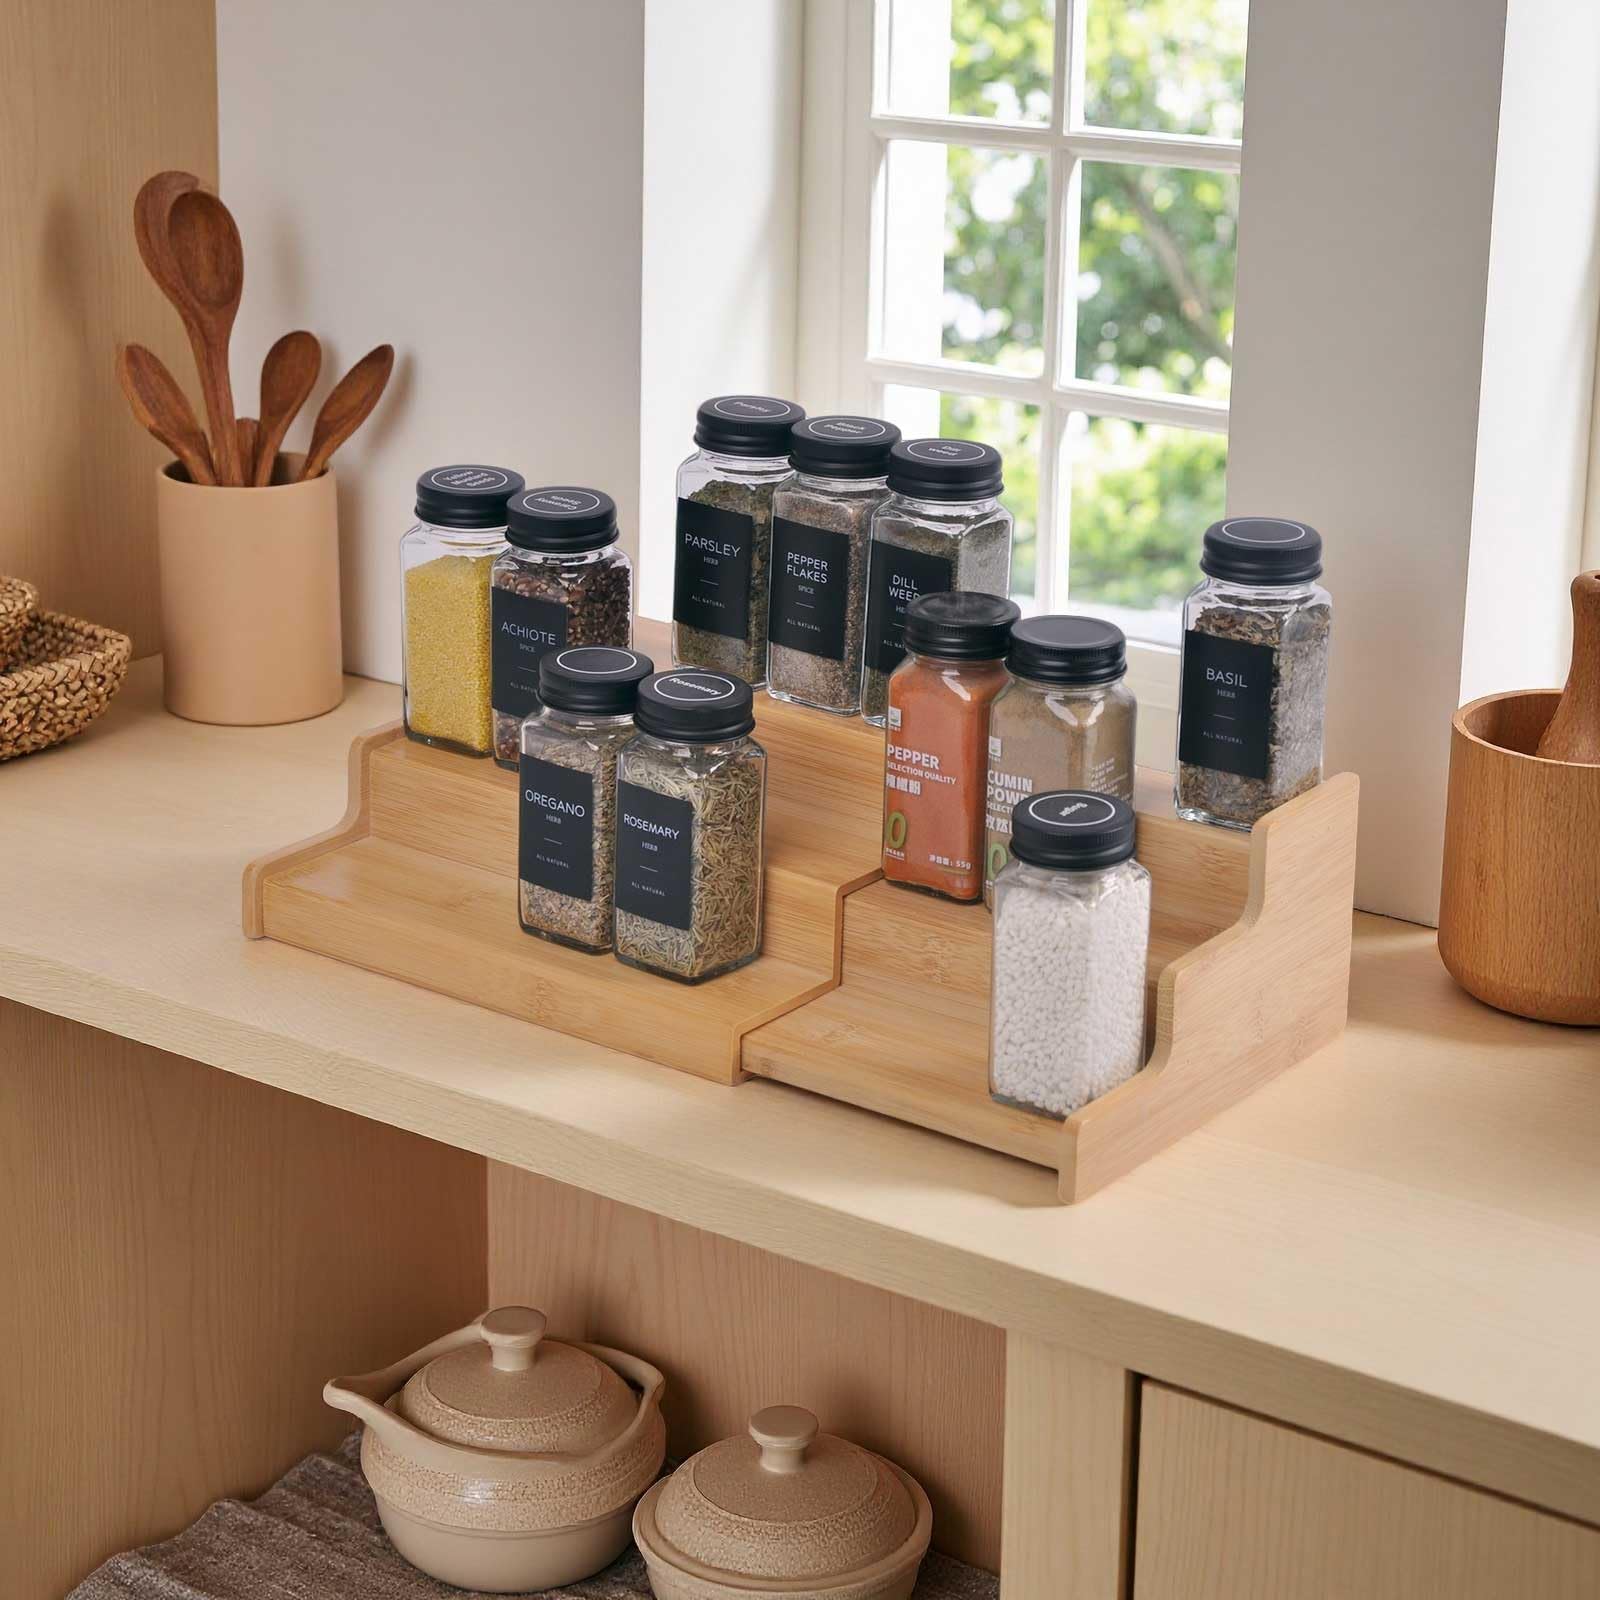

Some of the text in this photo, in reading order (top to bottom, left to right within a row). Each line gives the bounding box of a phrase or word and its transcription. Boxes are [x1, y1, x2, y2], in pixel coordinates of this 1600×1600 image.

[685, 533, 741, 557] PARSLEY
[787, 551, 829, 571] PEPPER
[786, 564, 828, 584] FLAKES
[892, 574, 918, 591] DILL
[501, 621, 557, 646] ACHIOTE
[786, 618, 821, 632] ALL NATURAL
[669, 677, 722, 696] Rosemary
[1207, 667, 1249, 688] BASIL
[887, 743, 940, 770] PEPPER
[924, 771, 957, 785] QUALITY
[988, 770, 1033, 793] CUMIN
[525, 789, 586, 818] OREGANO
[623, 813, 680, 840] ROSEMARY
[631, 881, 666, 897] ALL NATURAL
